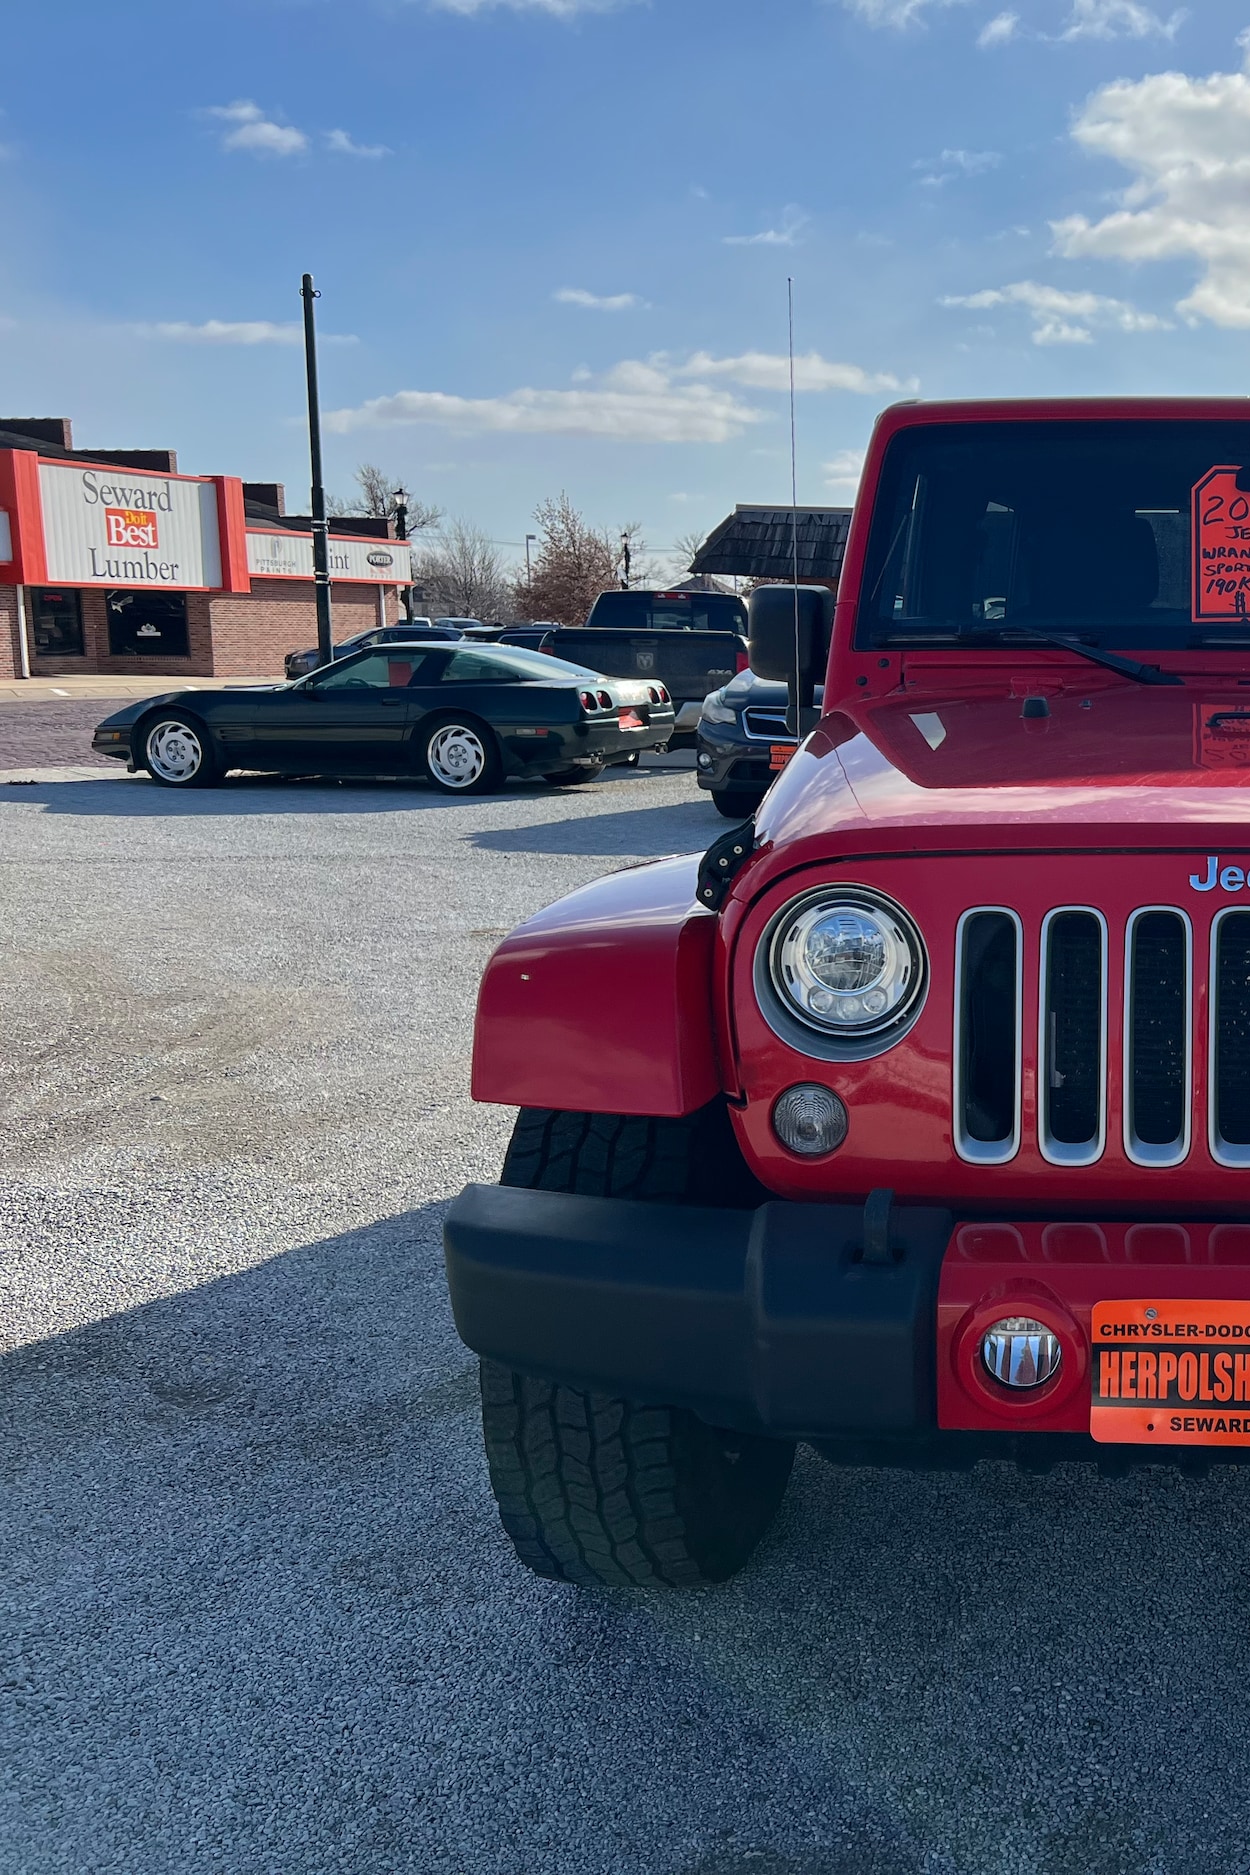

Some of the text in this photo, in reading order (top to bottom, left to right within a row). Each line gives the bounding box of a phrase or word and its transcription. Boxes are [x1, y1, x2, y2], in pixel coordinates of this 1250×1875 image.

[82, 471, 173, 512] Seward
[125, 510, 147, 525] Do it
[107, 515, 157, 547] Best
[88, 547, 179, 580] Lumber
[256, 559, 296, 568] PITTSBURGH
[261, 567, 293, 575] PAINTS
